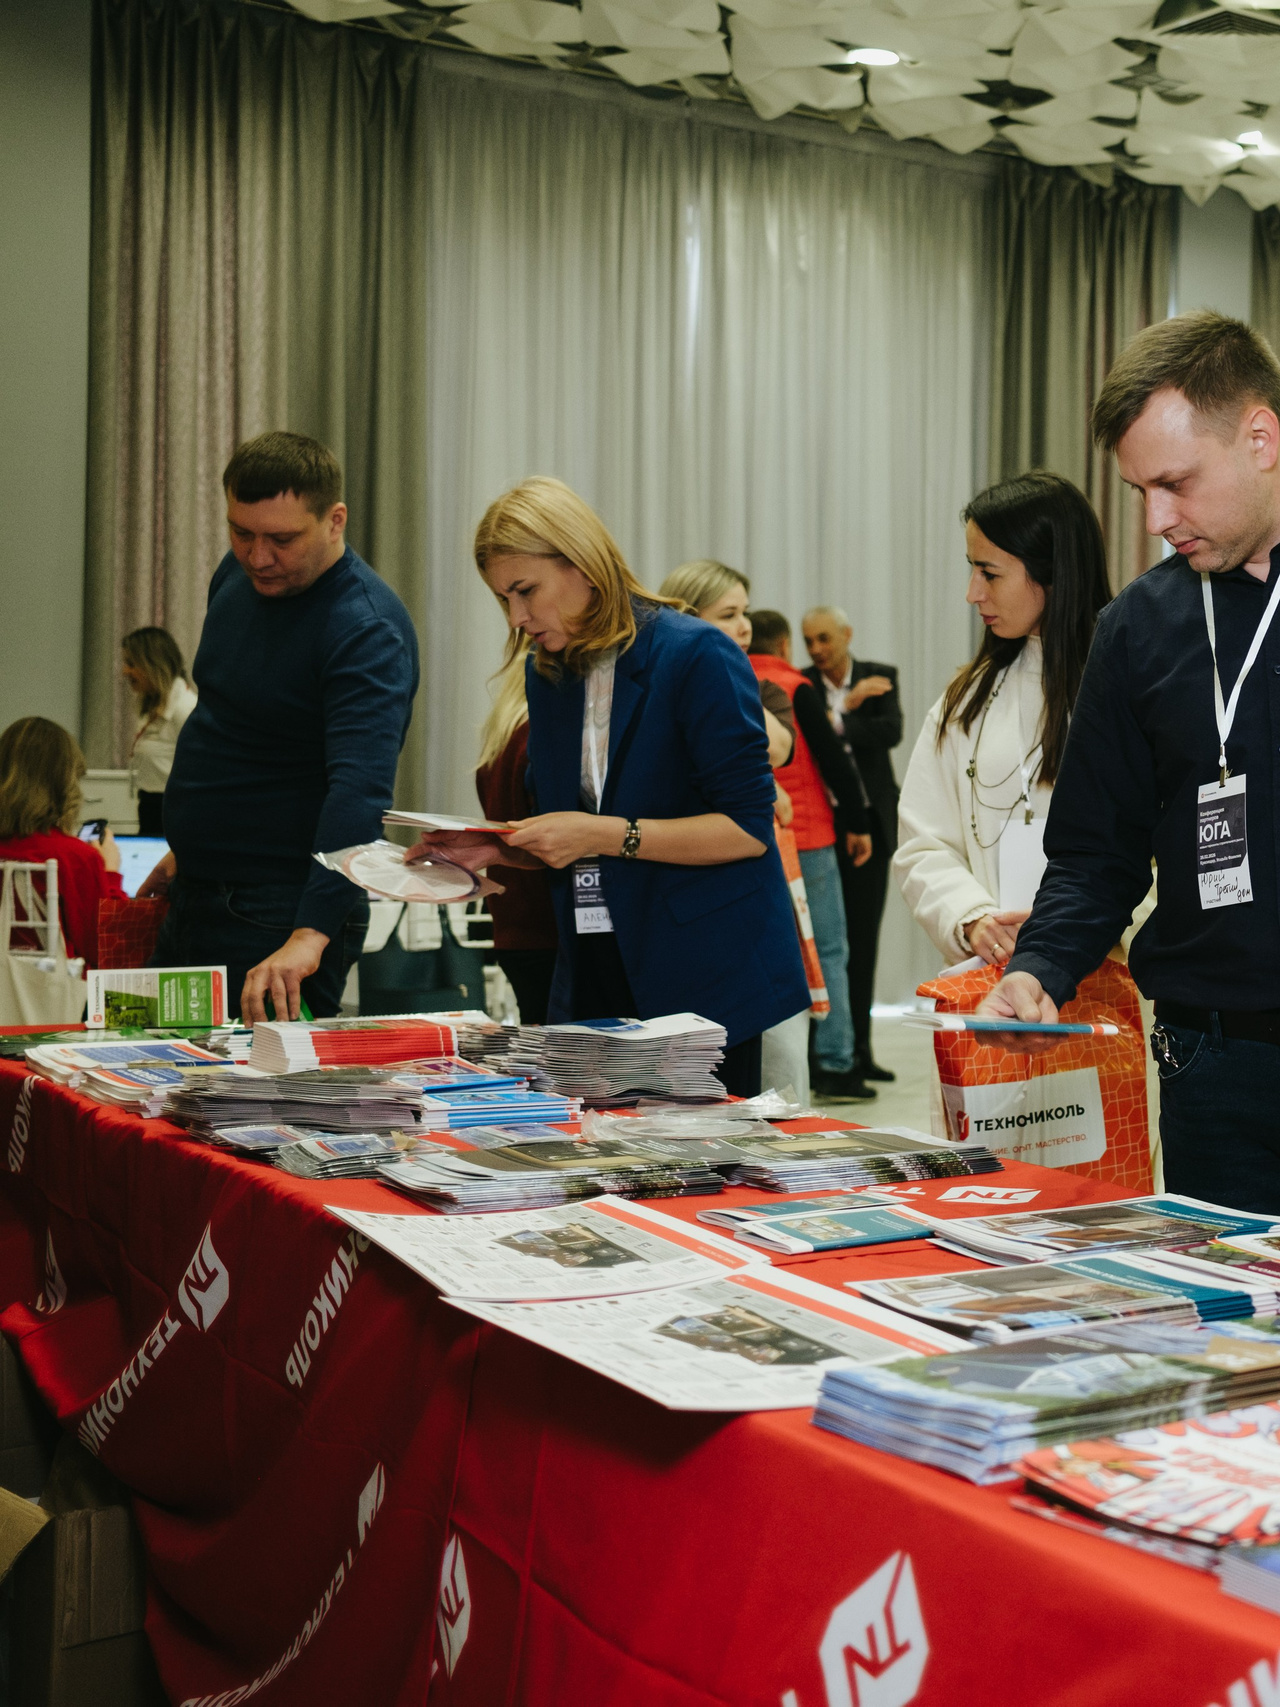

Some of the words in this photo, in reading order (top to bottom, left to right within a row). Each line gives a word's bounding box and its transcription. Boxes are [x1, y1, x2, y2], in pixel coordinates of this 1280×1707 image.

[1199, 820, 1231, 843] ЮГА
[575, 872, 602, 888] ЮГ
[974, 1104, 1085, 1132] ТЕХНОНИКОЛЬ
